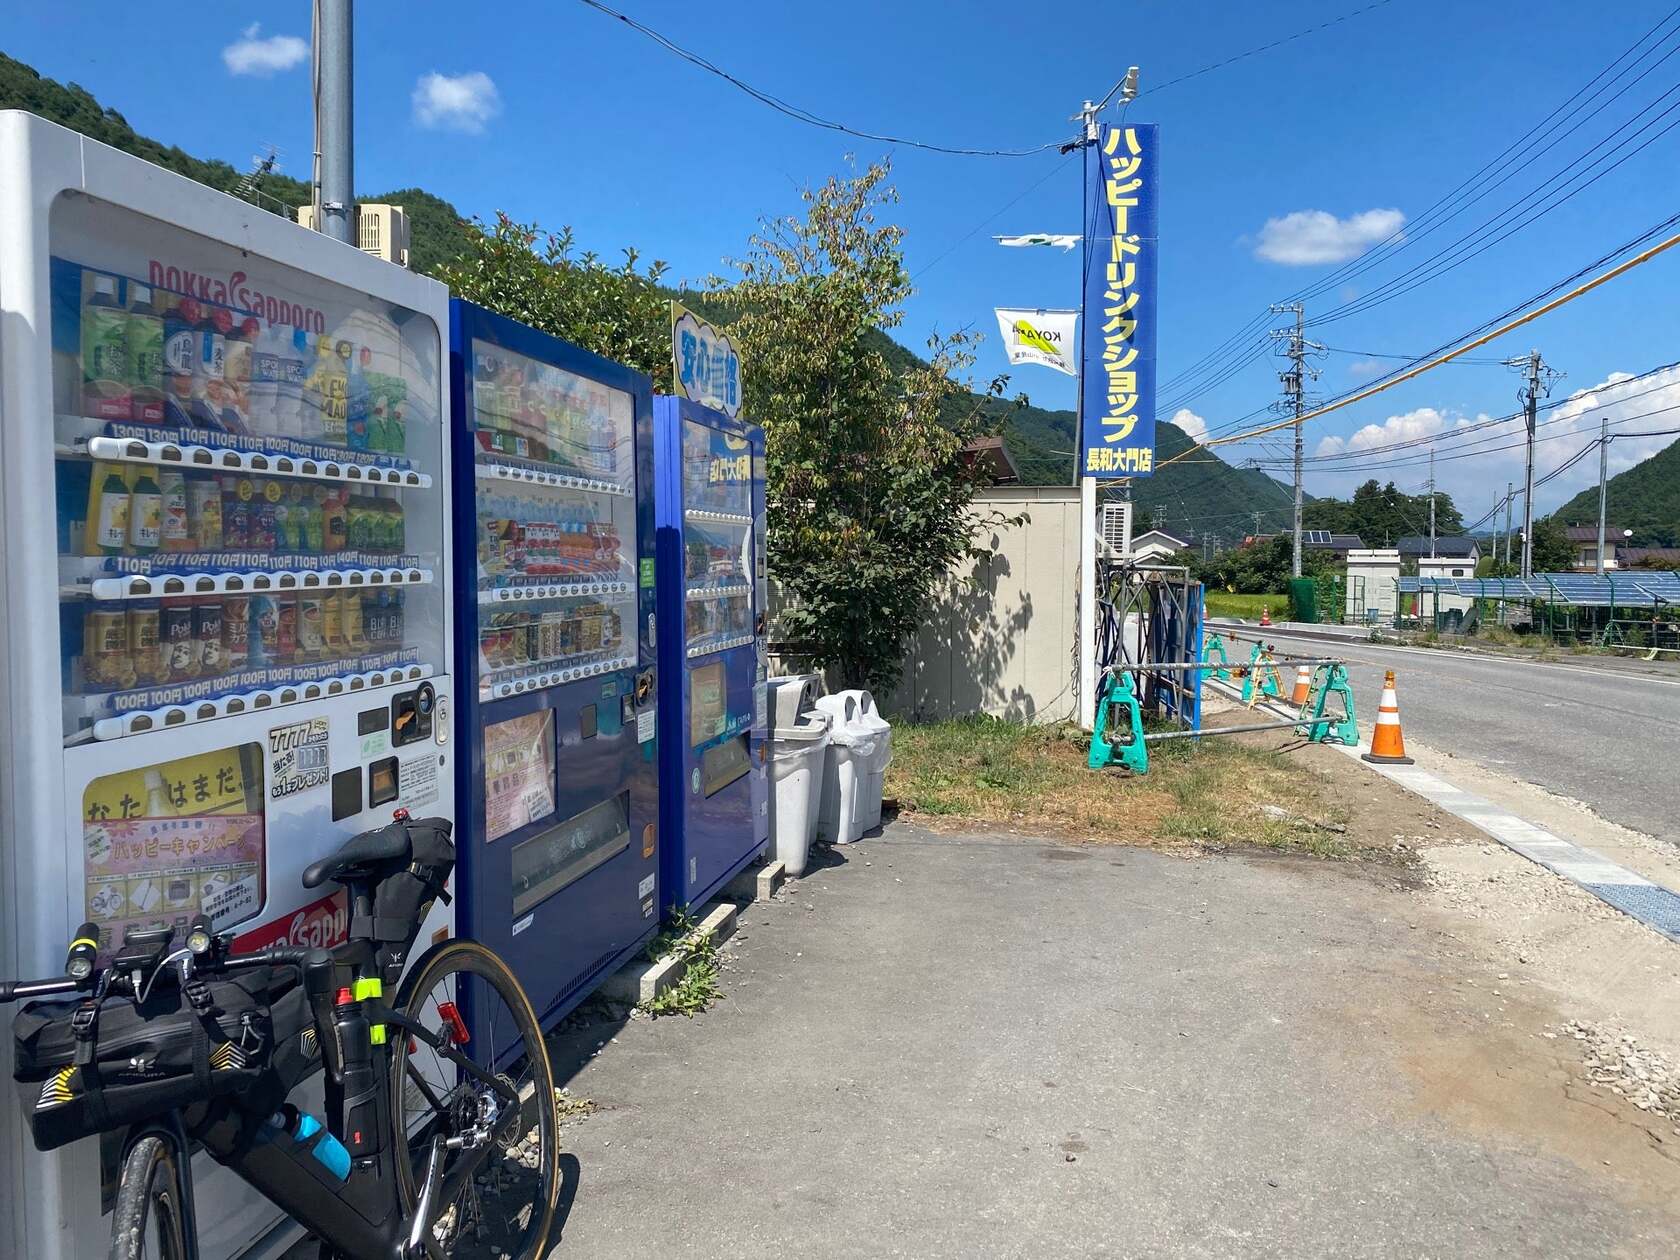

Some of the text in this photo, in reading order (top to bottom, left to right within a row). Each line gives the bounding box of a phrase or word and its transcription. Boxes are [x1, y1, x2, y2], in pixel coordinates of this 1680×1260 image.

[1102, 127, 1144, 444] ハッピードリンクショップ
[112, 424, 145, 440] 130円
[147, 428, 179, 443] 130円
[180, 427, 208, 444] 110円
[210, 431, 237, 447] 110円
[239, 435, 264, 450] 110円
[336, 450, 356, 463] 30円
[1086, 447, 1154, 473] 長和大門店
[117, 557, 151, 574] 110円
[151, 553, 177, 566] 10円
[180, 553, 209, 566] 110円
[211, 553, 240, 566] 110円
[241, 553, 268, 567] 110円
[269, 555, 292, 569] 110円
[294, 555, 318, 569] 110円
[319, 555, 336, 566] 10円
[318, 662, 339, 677] 100円
[362, 657, 381, 670] 110円
[241, 670, 266, 685] 100円
[269, 667, 292, 681] 100円
[294, 667, 317, 680] 100円
[183, 681, 211, 698] 100円
[214, 674, 239, 690] 100円
[114, 693, 148, 710] 100円
[152, 687, 182, 705] 100円
[270, 722, 312, 753] 7777
